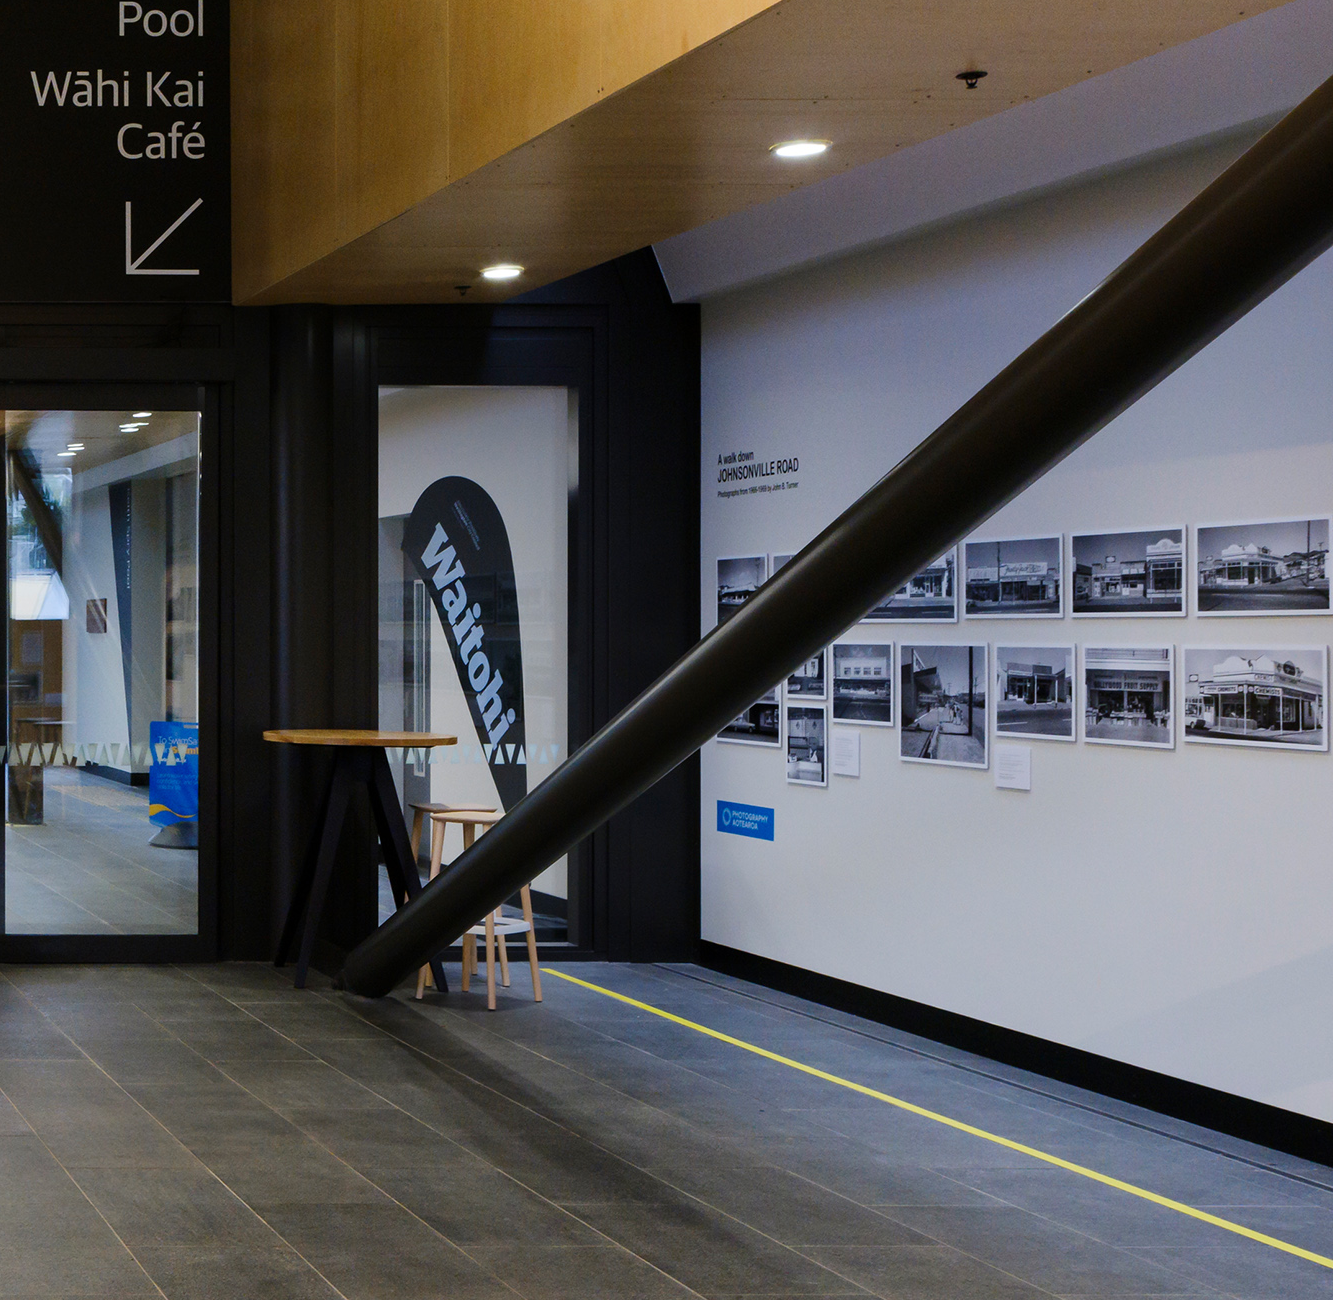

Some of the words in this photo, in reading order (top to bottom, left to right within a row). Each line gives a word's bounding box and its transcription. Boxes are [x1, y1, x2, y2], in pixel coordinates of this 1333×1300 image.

[119, 0, 204, 37] Pool
[30, 69, 130, 107] Wāhi
[146, 70, 204, 107] Kai
[117, 120, 206, 159] Café
[717, 461, 775, 483] JOHNSONVILLE
[777, 457, 799, 474] ROAD
[718, 454, 722, 465] A
[723, 452, 736, 464] walk
[738, 451, 754, 462] down
[421, 522, 516, 750] Waitohi
[732, 810, 769, 823] PHOTOGRAPHY
[732, 819, 758, 830] AOTEAROA
